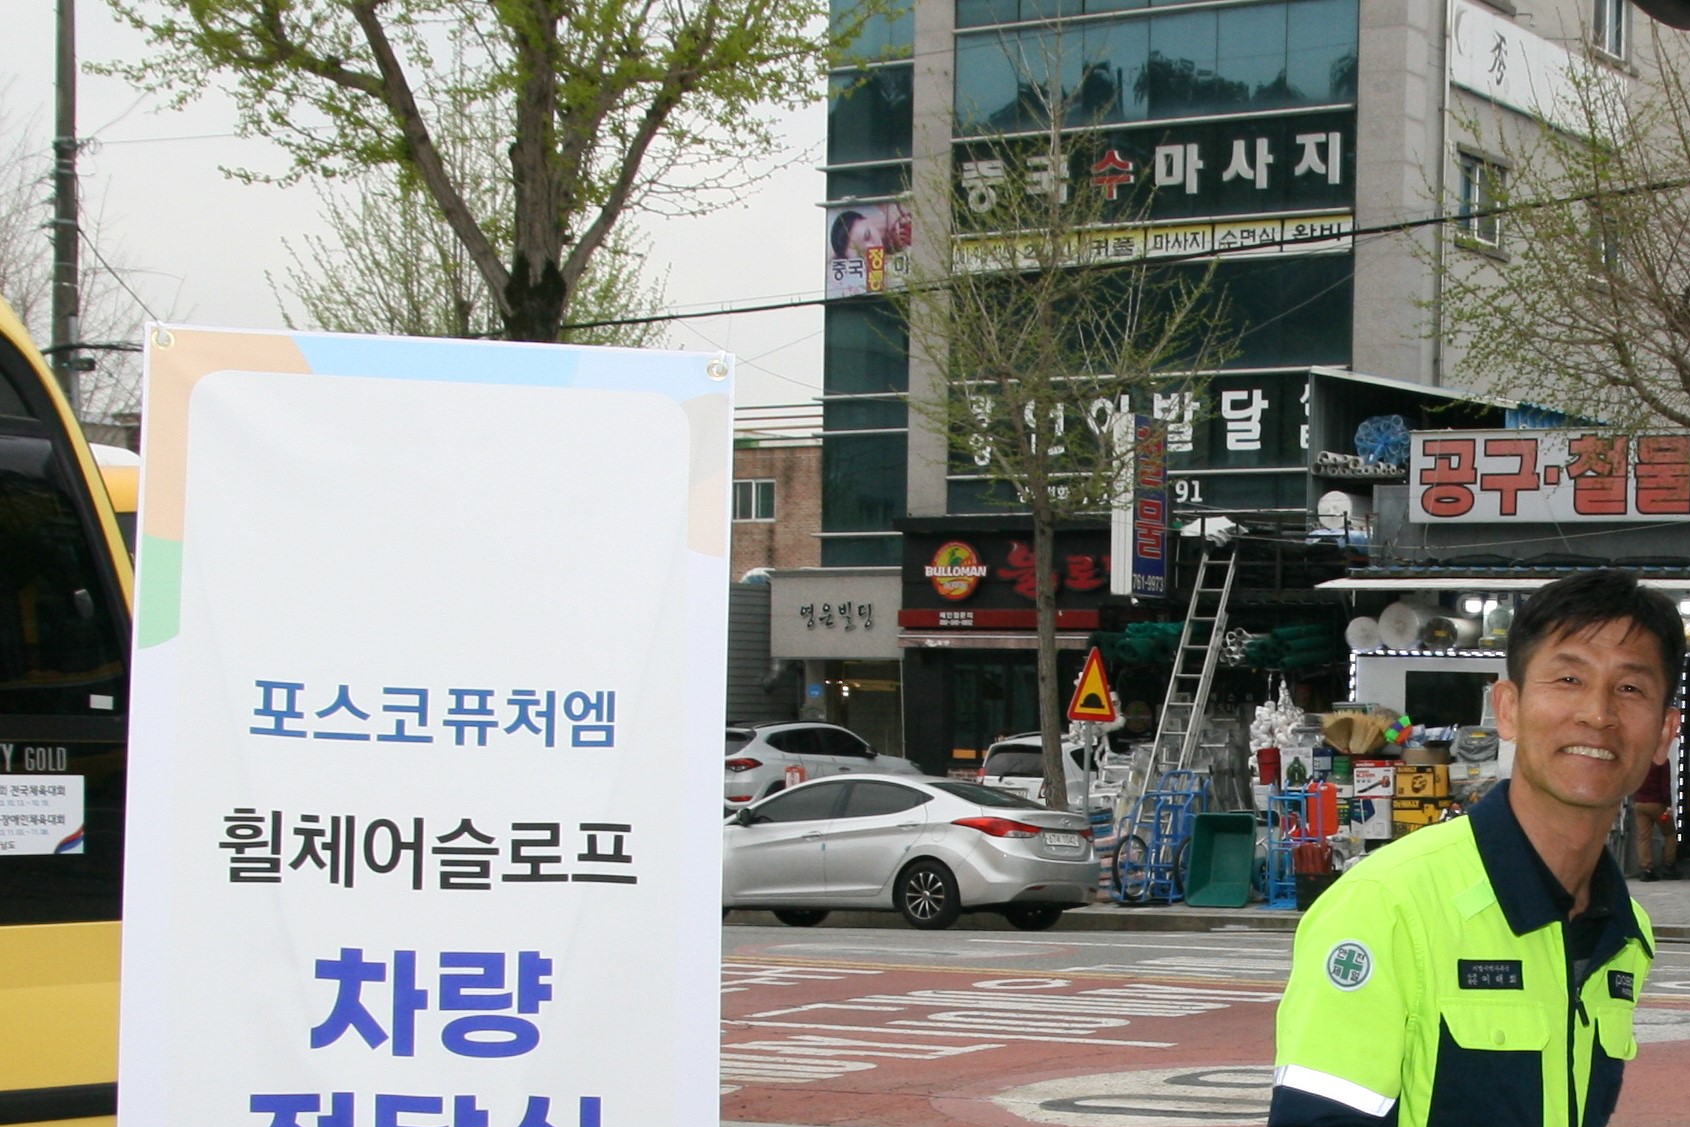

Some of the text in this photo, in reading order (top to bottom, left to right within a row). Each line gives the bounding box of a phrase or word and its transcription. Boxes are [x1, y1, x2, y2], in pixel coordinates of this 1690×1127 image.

[924, 565, 988, 578] BULLOMAN
[250, 680, 617, 748] 포스코퓨처엠
[24, 747, 68, 771] GOLD
[218, 808, 638, 891] 휠체어슬로프
[310, 947, 554, 1058] 차량
